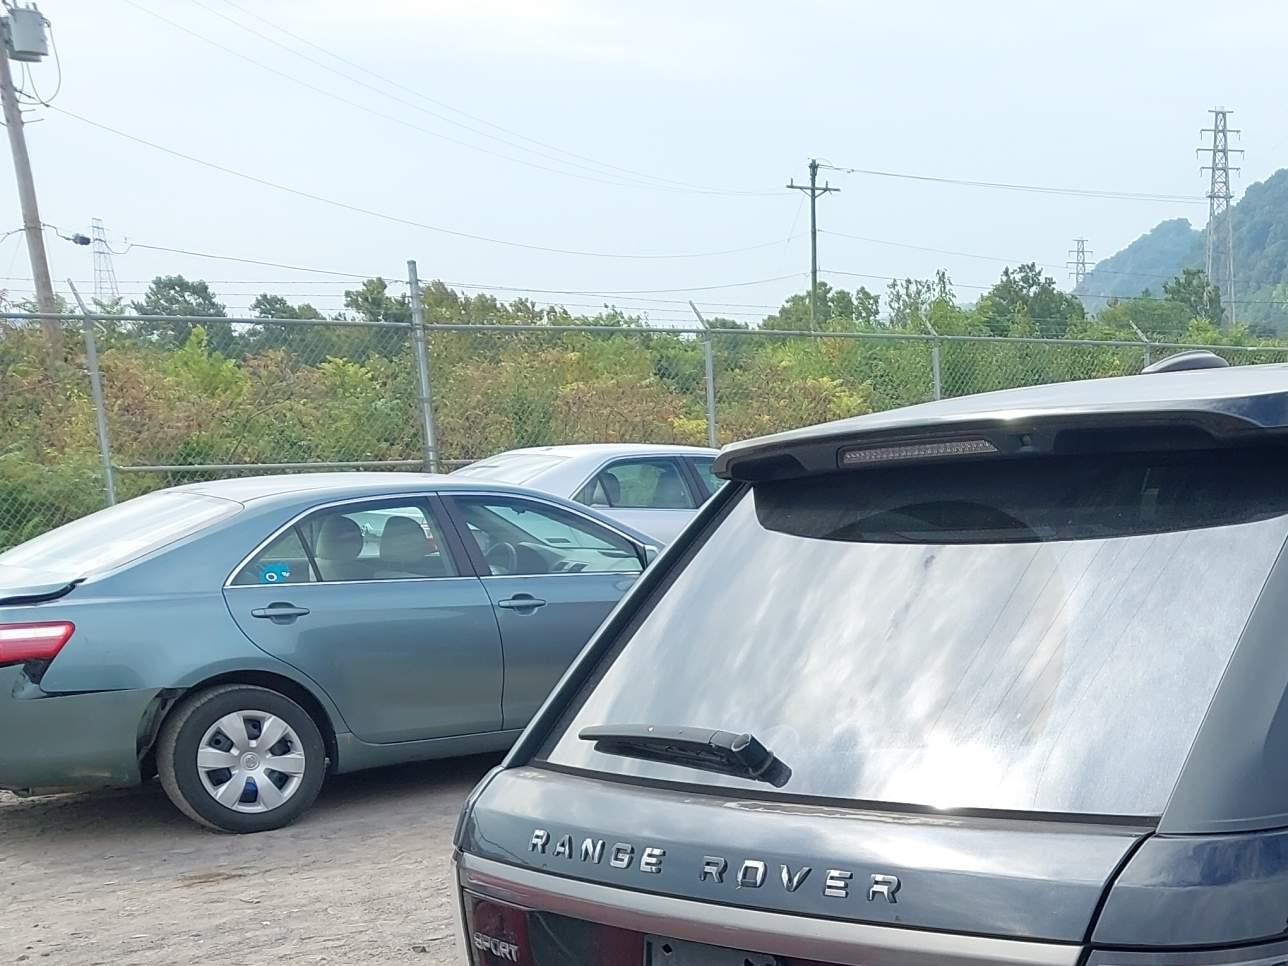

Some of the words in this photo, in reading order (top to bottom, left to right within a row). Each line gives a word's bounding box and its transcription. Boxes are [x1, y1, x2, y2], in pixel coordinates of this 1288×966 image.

[528, 829, 666, 874] RANGE
[700, 855, 903, 904] ROVER
[473, 931, 519, 963] SPORT
